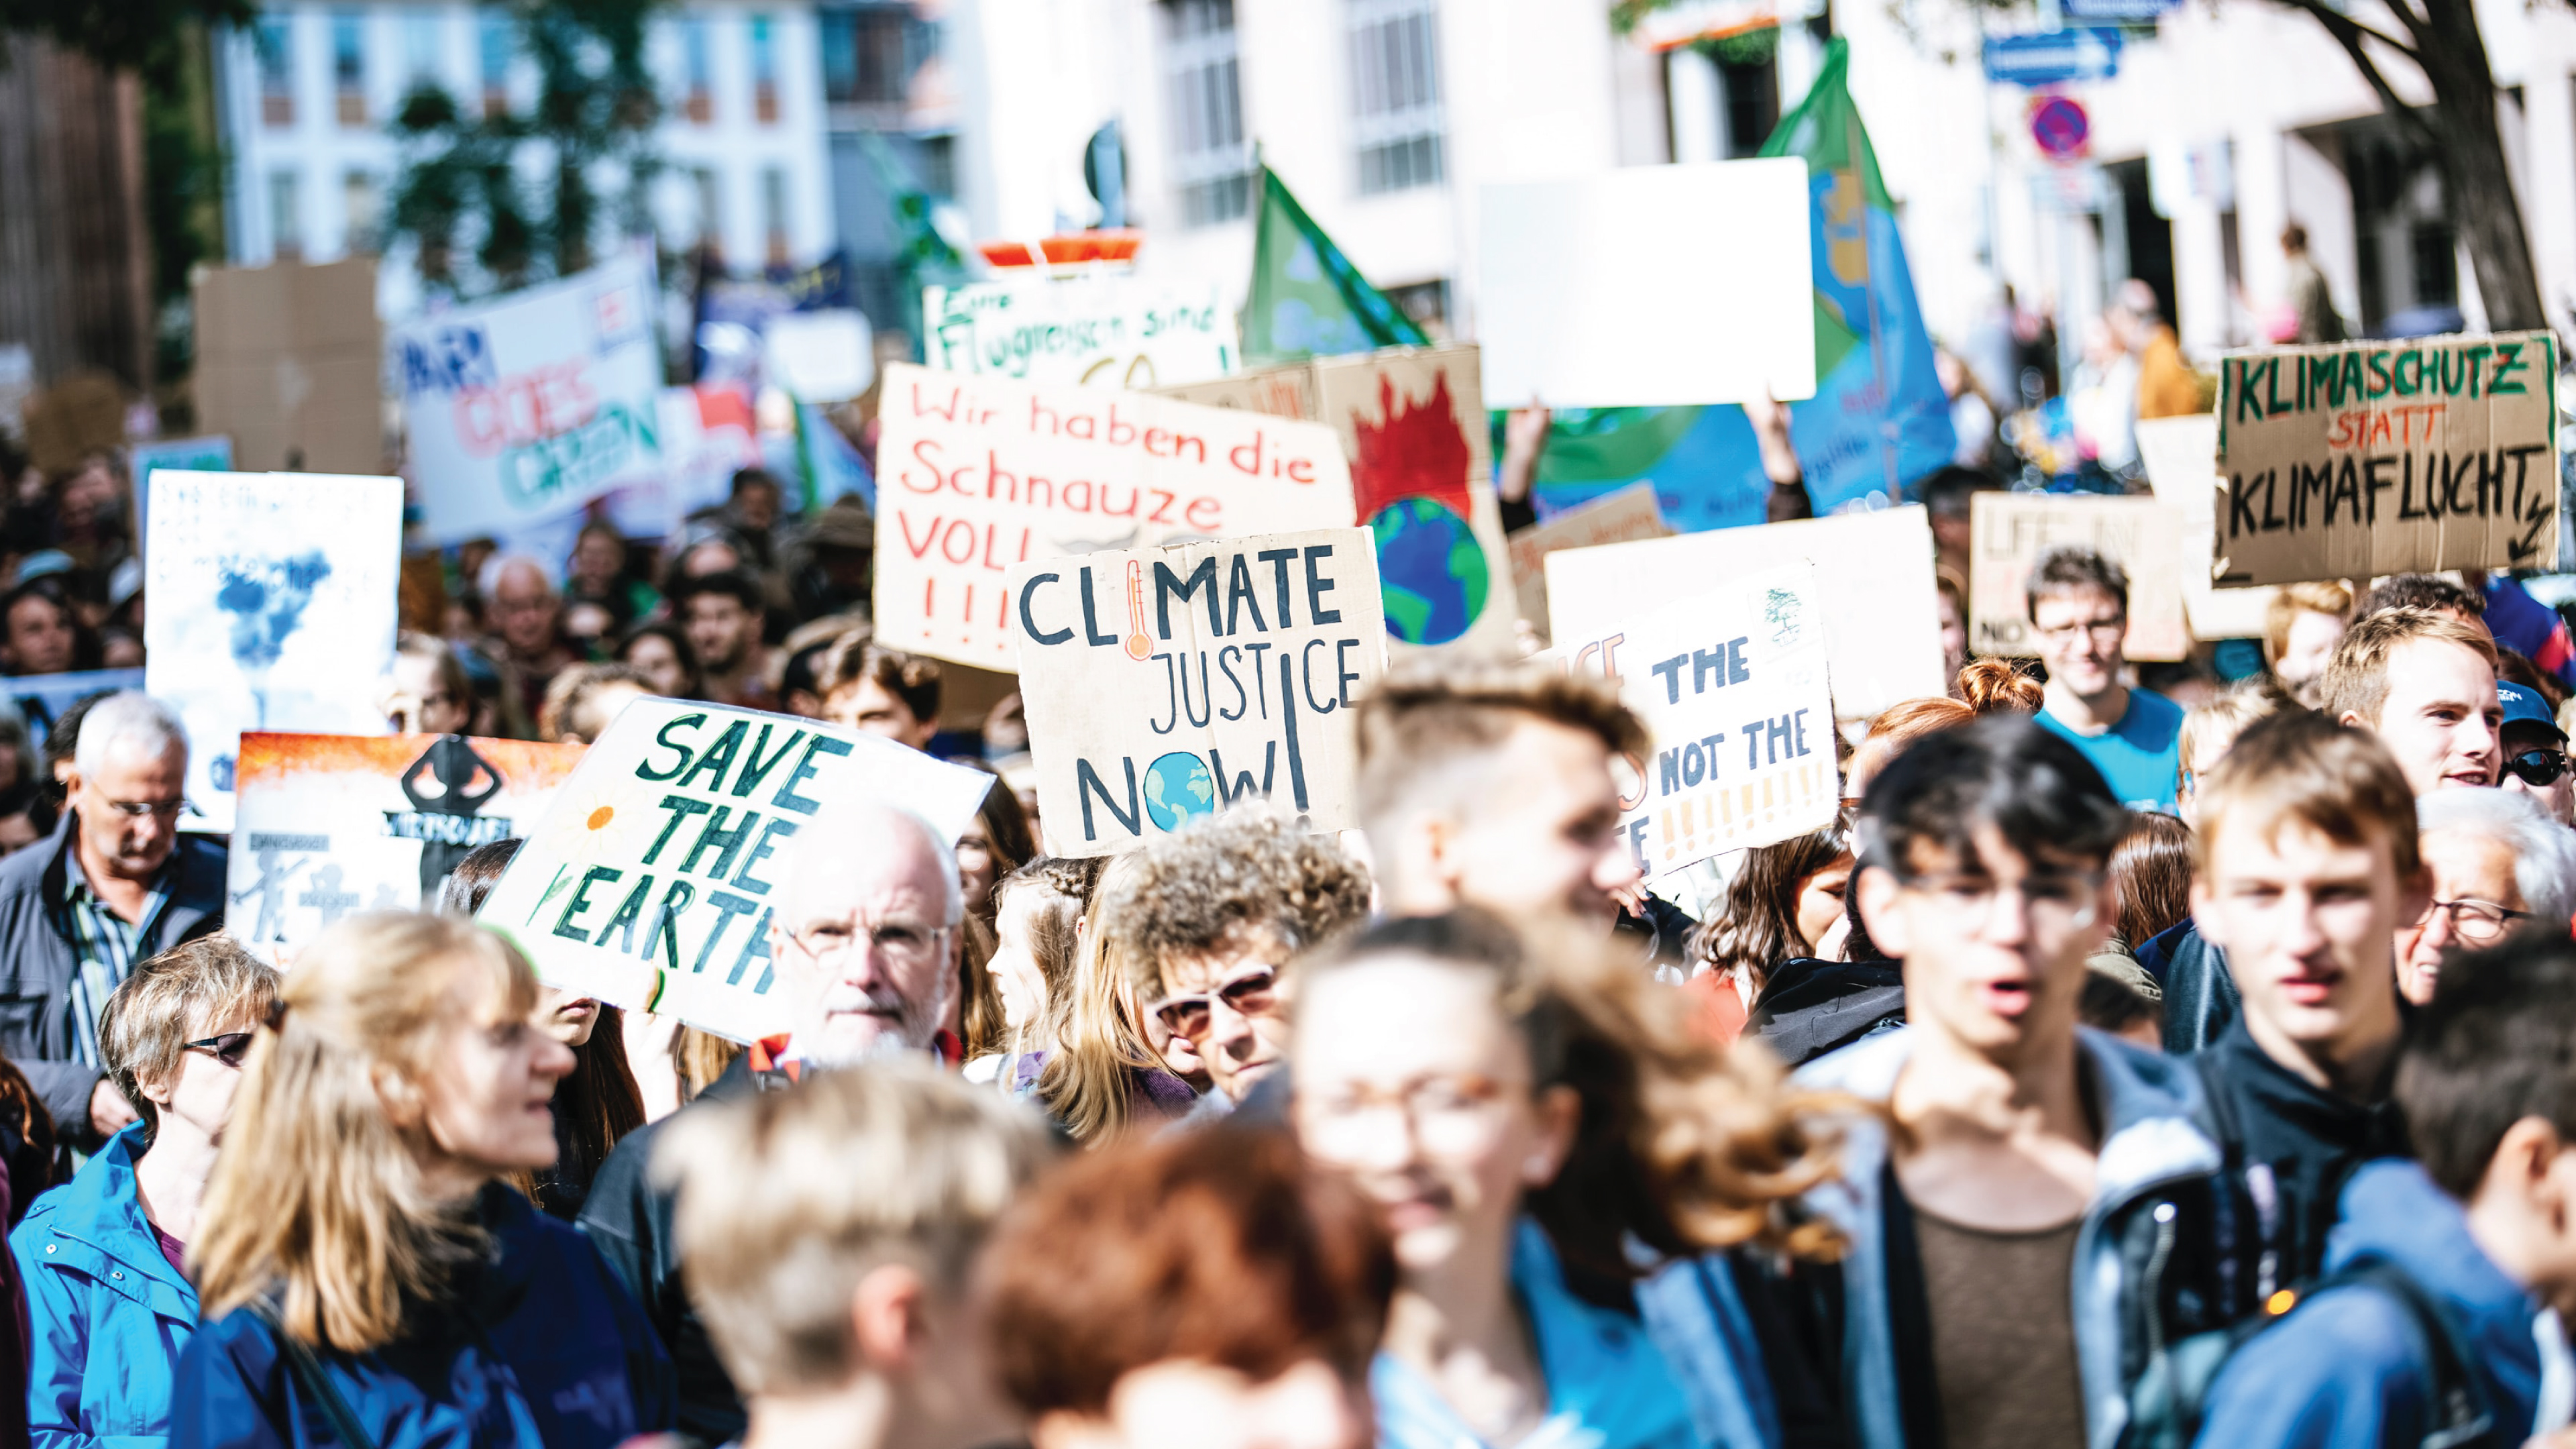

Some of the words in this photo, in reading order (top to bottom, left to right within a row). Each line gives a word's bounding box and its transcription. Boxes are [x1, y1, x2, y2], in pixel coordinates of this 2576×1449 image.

[2237, 343, 2530, 423] KLIMASCHUTZ
[2328, 403, 2447, 449] STATT
[912, 382, 998, 425] Wir
[1030, 395, 1206, 464] haben
[1229, 430, 1317, 484] die
[900, 439, 1222, 532] Schnauze
[2229, 445, 2546, 540] KLIMAFLUCHT
[1019, 545, 1342, 661] CLIMATE
[1151, 639, 1360, 765] JUSTICE
[1652, 636, 1750, 704] THE
[635, 713, 855, 817] SAVE
[1659, 733, 1725, 796] NOT
[1742, 708, 1811, 770] THE
[641, 794, 803, 896] THE
[551, 865, 775, 996] EARTH
